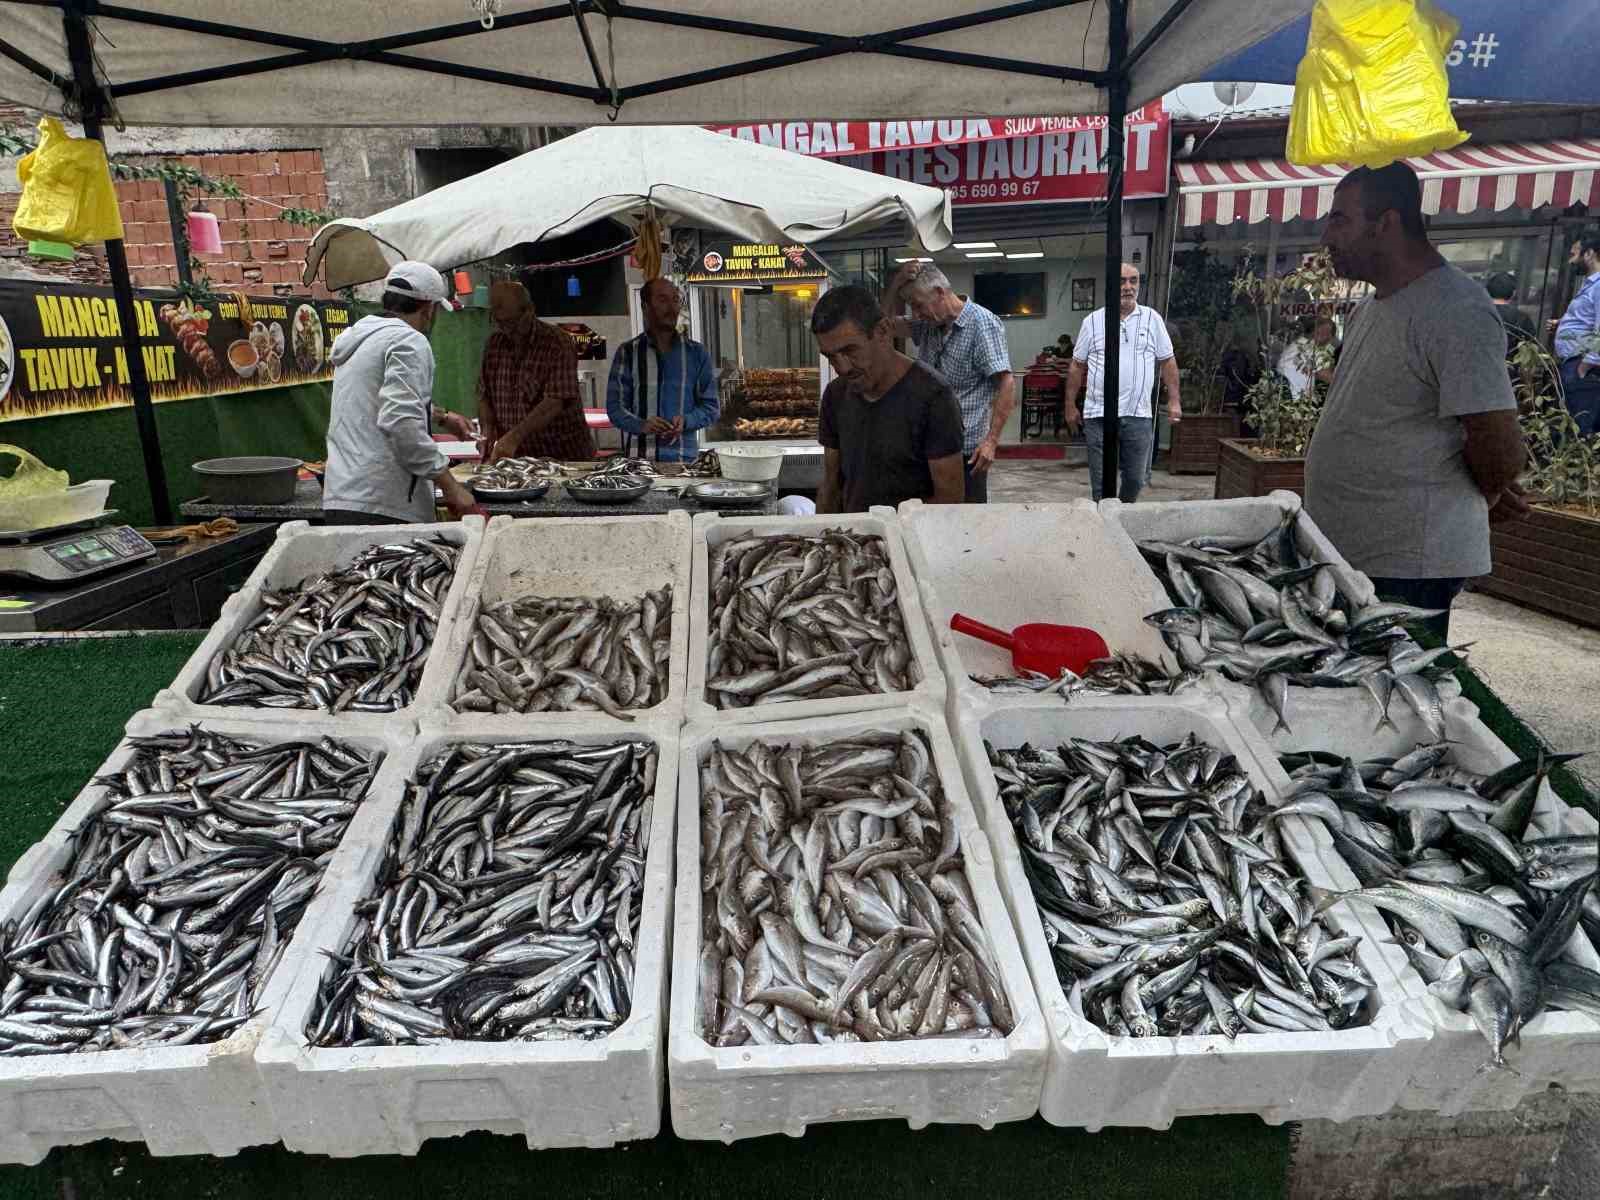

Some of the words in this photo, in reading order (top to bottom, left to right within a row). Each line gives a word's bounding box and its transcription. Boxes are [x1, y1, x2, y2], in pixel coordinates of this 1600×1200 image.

[718, 120, 855, 155] ANGAL
[1004, 117, 1036, 135] SULU
[1040, 115, 1082, 131] YEMEK
[971, 183, 997, 197] 690
[1001, 181, 1019, 196] 99
[1022, 180, 1041, 195] 67
[724, 258, 753, 270] TAVUK
[758, 256, 787, 269] KANAT
[732, 244, 780, 257] MANGALDA
[35, 295, 160, 338] MANGADA
[19, 347, 102, 392] TAVUK
[114, 345, 177, 385] KNAT
